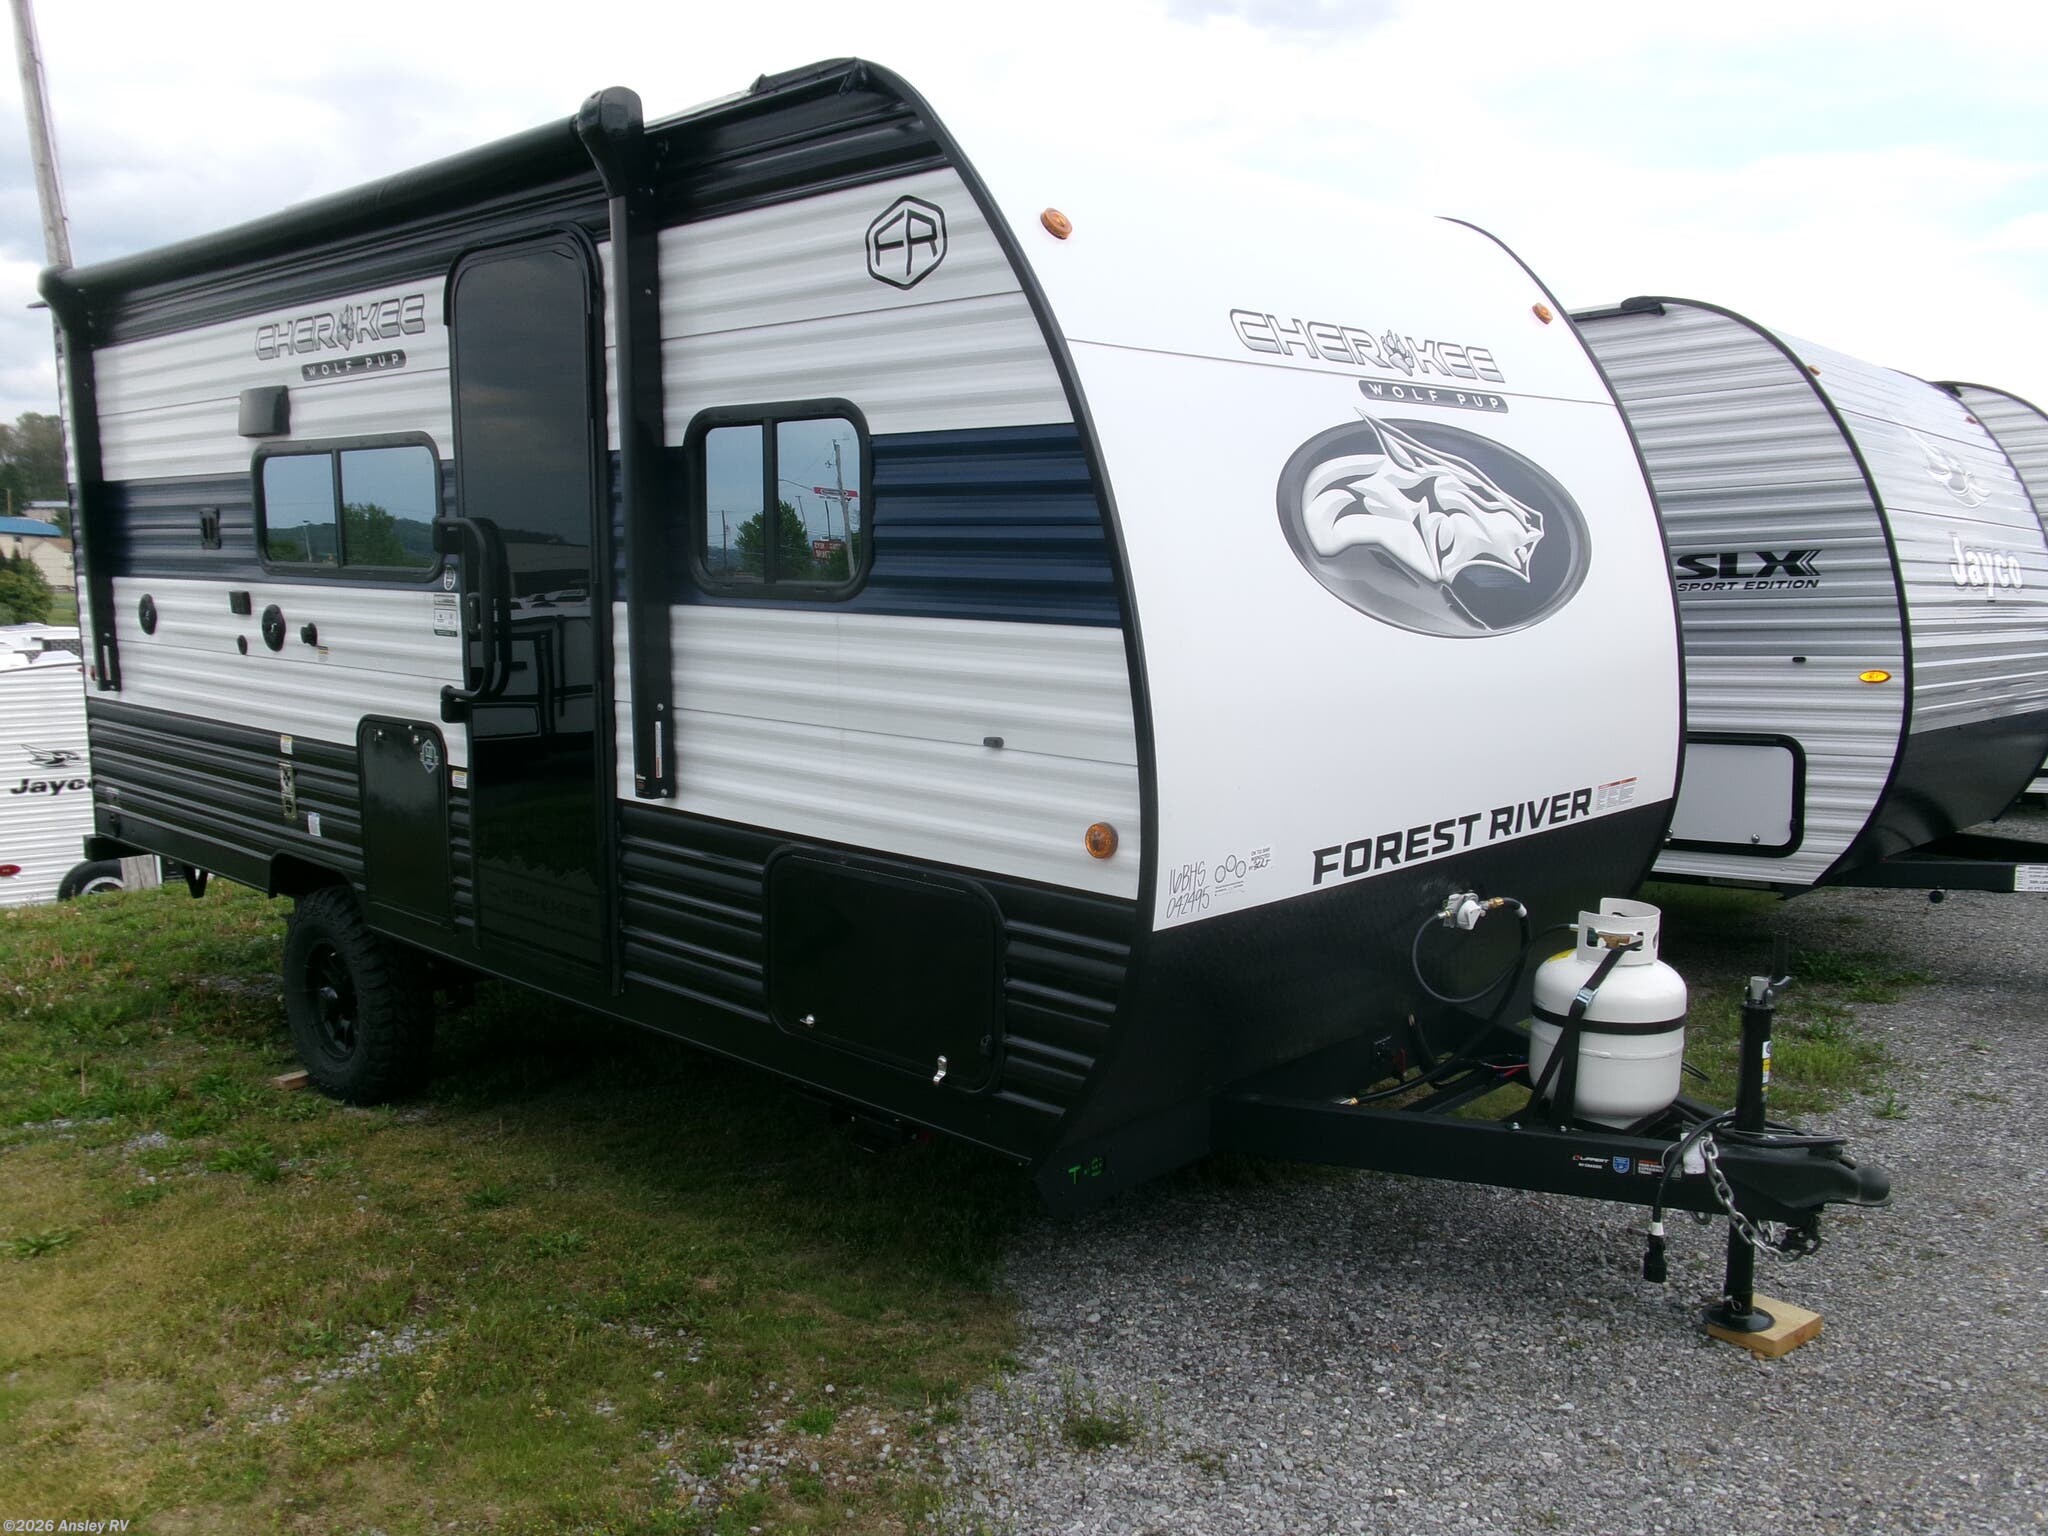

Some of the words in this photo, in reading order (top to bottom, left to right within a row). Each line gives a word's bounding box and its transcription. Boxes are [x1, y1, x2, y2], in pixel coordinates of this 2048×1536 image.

[255, 294, 426, 361] CHEROKEE
[1229, 308, 1506, 384] CHEROKEE
[306, 360, 353, 377] WOLF
[365, 353, 400, 369] PUP
[1368, 382, 1439, 402] WOLF
[1456, 392, 1501, 410] PUP
[1675, 549, 1823, 581] SLX
[1949, 532, 2023, 600] Jayco
[1677, 581, 1738, 592] SPORT
[1743, 579, 1820, 591] EDITION
[9, 778, 93, 797] Jayc
[1311, 812, 1483, 886] FOREST
[1488, 786, 1593, 841] RIVER
[1168, 861, 1207, 896] 16BHS
